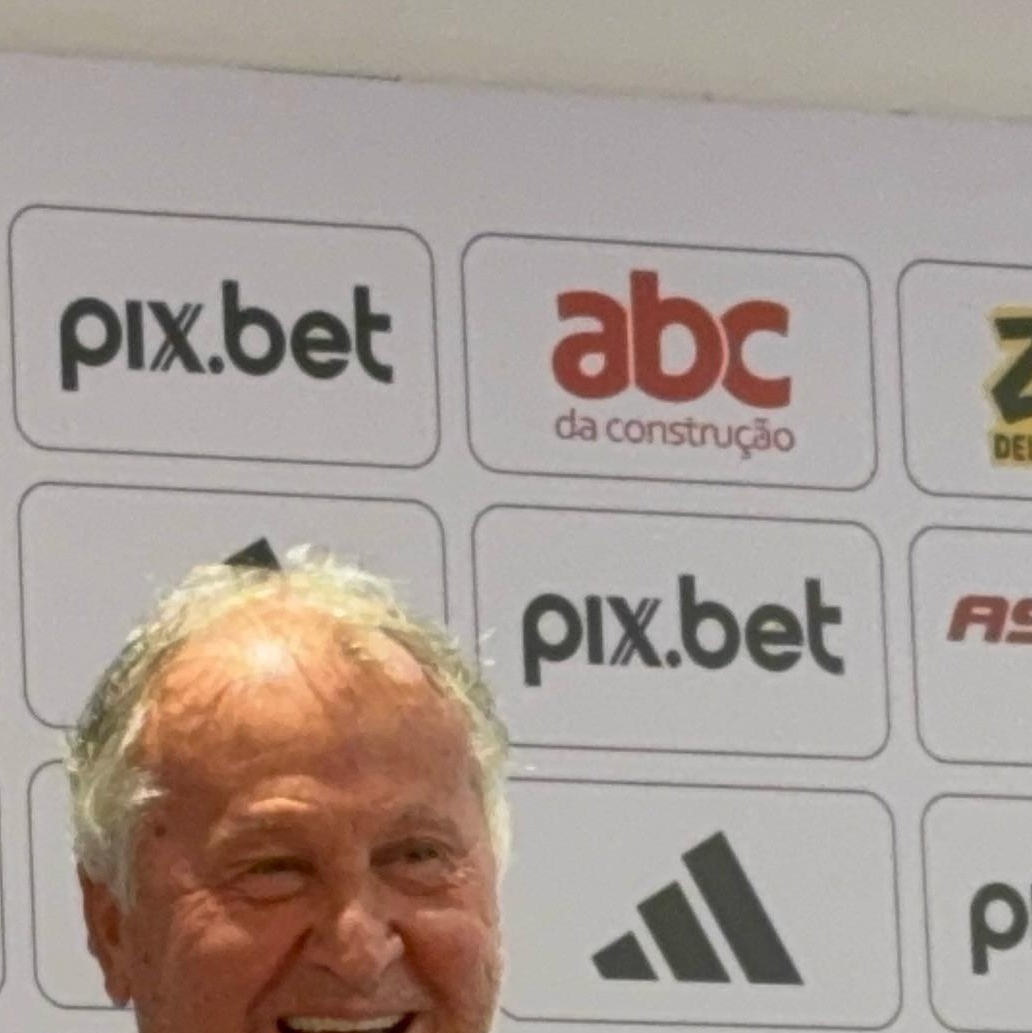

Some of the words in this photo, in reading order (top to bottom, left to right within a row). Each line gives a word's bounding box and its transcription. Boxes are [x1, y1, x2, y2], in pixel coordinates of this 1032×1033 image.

[59, 279, 394, 392] pix.bet
[551, 269, 792, 409] abc
[555, 409, 597, 442] da
[605, 415, 796, 459] construção
[522, 574, 845, 687] pix.bet
